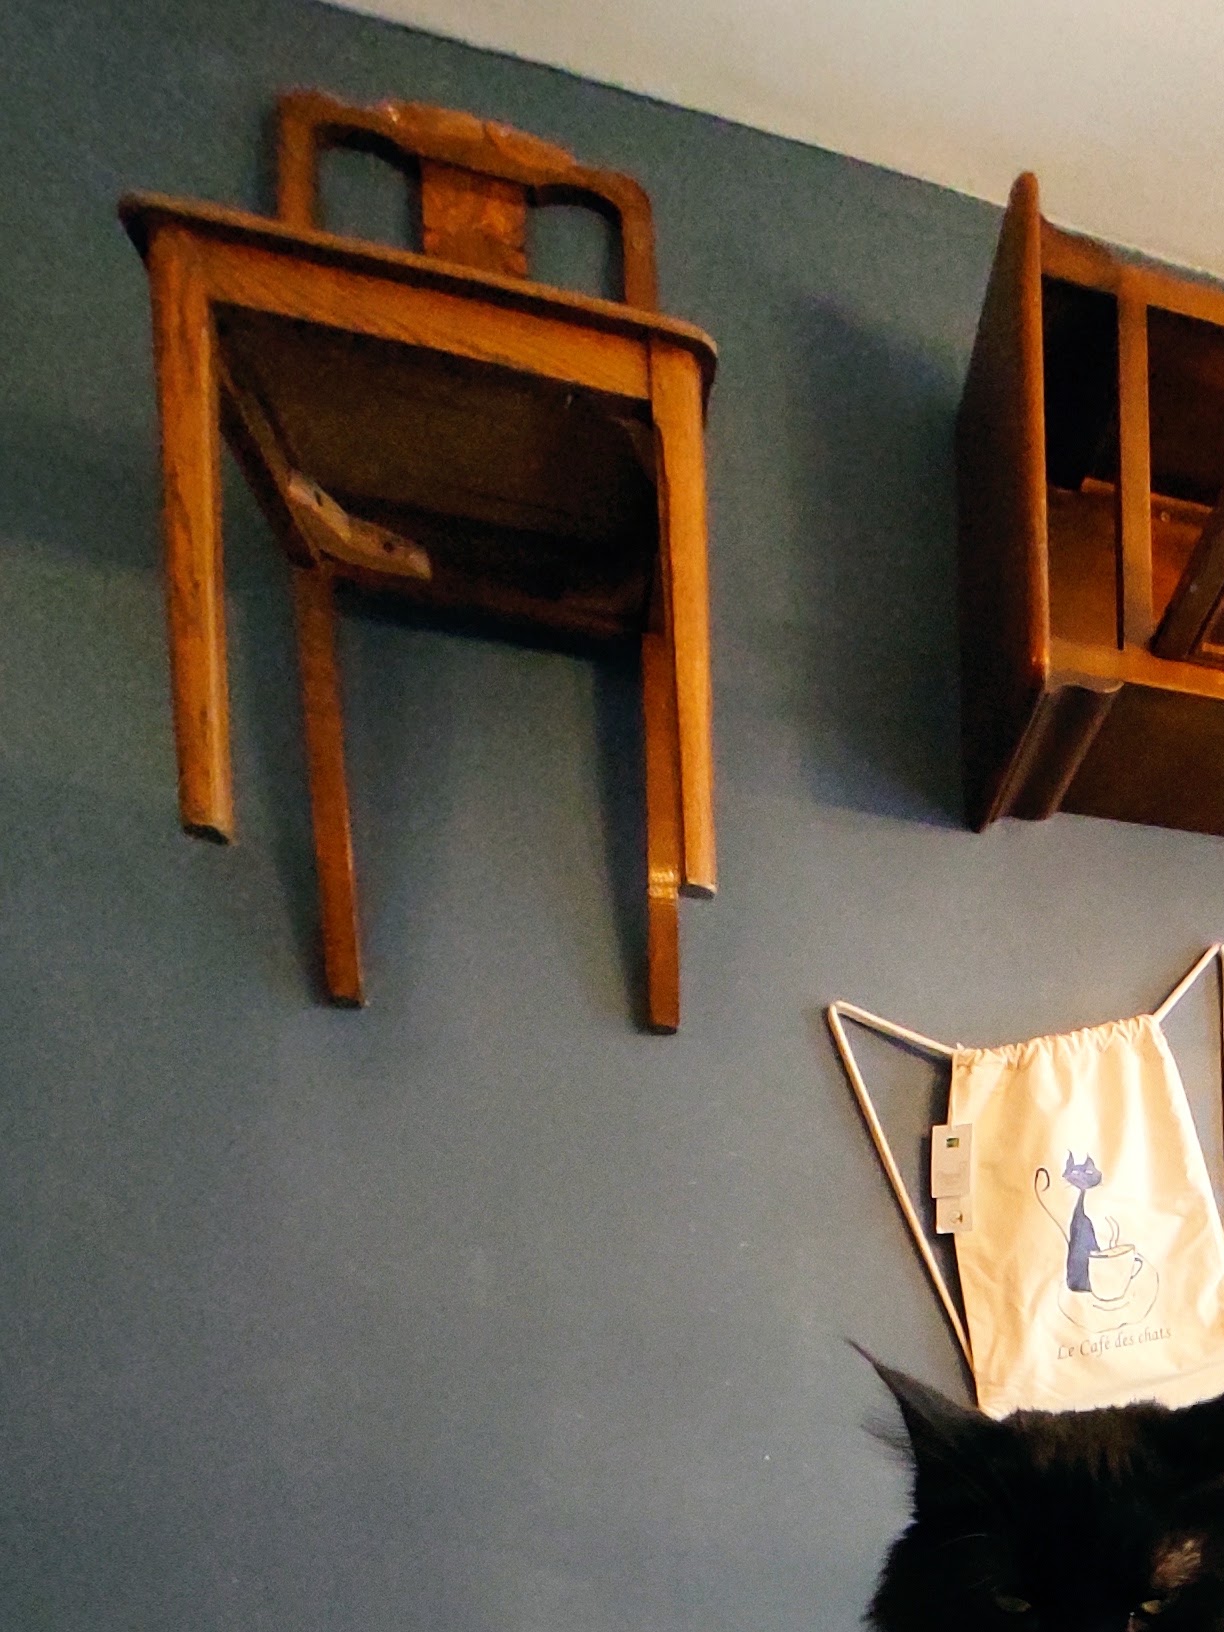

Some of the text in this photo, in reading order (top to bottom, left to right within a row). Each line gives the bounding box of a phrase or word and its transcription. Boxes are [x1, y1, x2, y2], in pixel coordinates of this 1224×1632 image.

[1057, 1326, 1171, 1359] Le Café des chats
